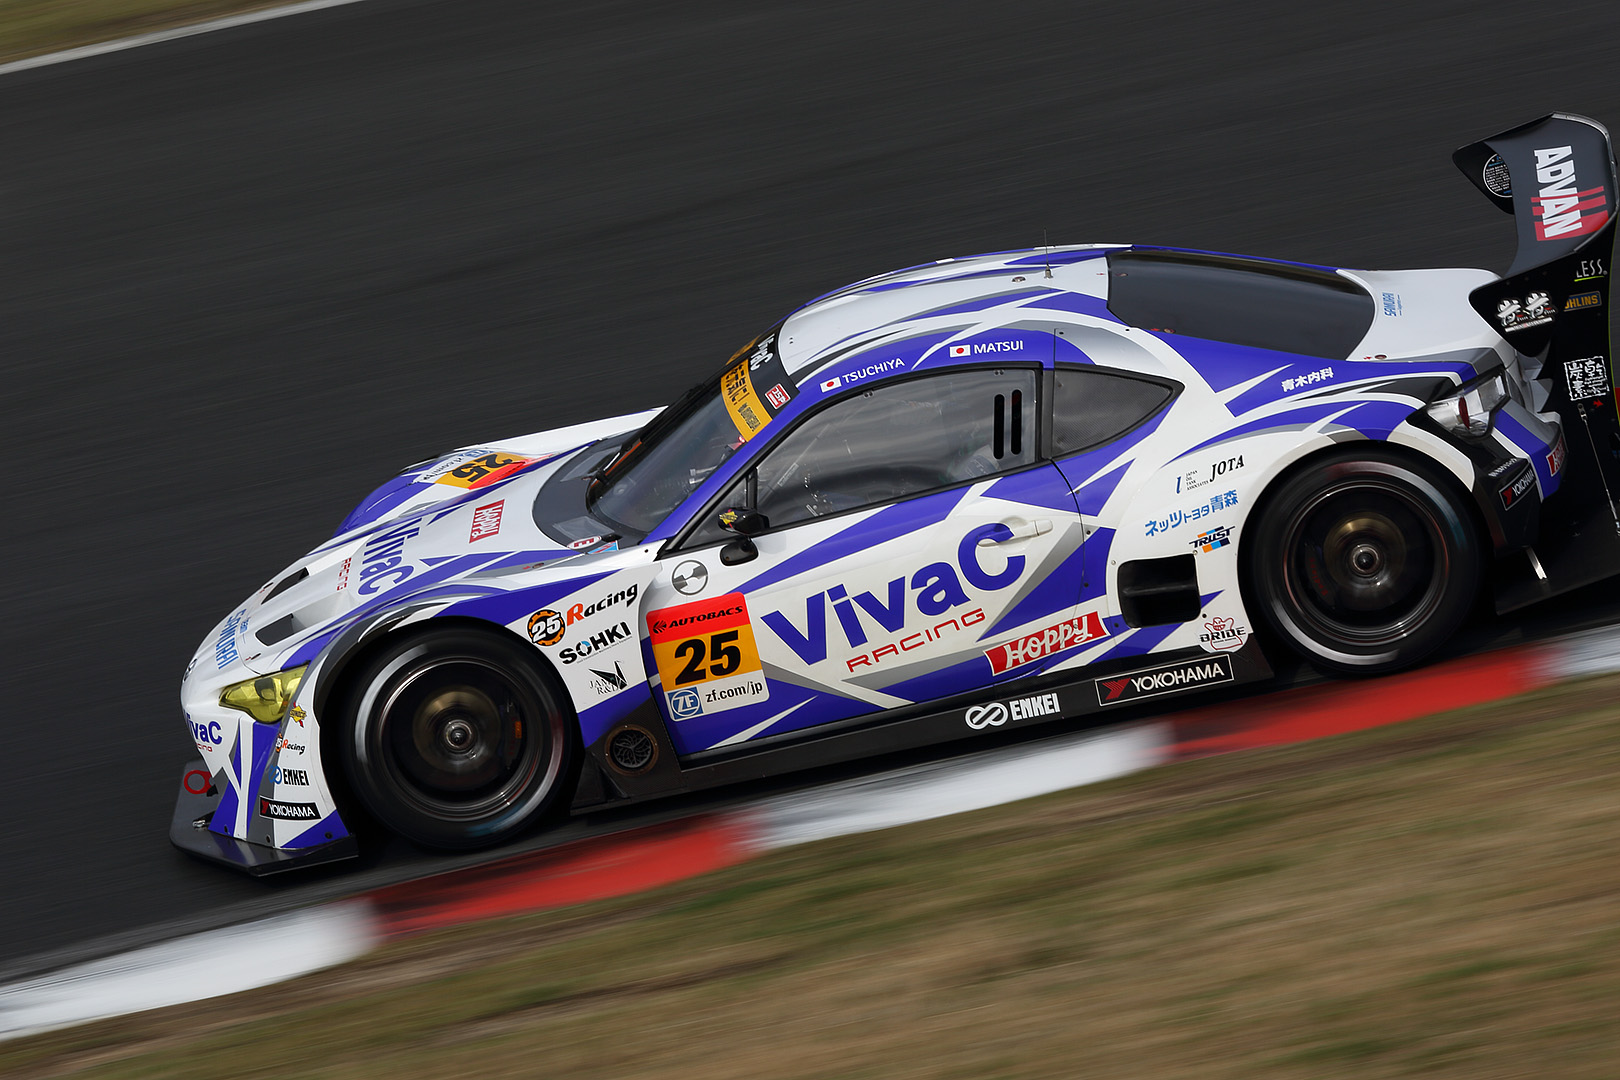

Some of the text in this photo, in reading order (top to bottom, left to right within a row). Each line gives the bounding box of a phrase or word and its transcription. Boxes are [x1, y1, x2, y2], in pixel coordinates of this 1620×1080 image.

[1534, 146, 1583, 238] ADVAN
[973, 340, 1024, 355] MATSUI
[842, 357, 905, 384] TSUCHIYA
[1281, 366, 1334, 392] 青木内科
[452, 453, 513, 482] 25
[1209, 455, 1244, 482] JOTA
[1145, 489, 1239, 537] ネッツトヨタ青森
[1189, 526, 1235, 548] TRUST
[358, 518, 422, 595] VivaC
[760, 523, 1026, 666] VivaC
[531, 583, 638, 644] 25 Racing
[668, 605, 743, 629] AUTOBACS
[216, 608, 247, 669] SAMURAI
[559, 621, 632, 665] SOHKI
[846, 607, 986, 673] RACING
[1003, 616, 1092, 668] Hoppy
[1199, 626, 1246, 643] BRIDE
[674, 629, 741, 686] 25
[1131, 662, 1225, 692] YOKOHAMA
[676, 680, 763, 713] ZF zf.com/jp
[1010, 693, 1060, 721] ENKEI
[282, 739, 306, 756] Racing
[283, 768, 310, 786] ENKEI
[269, 803, 316, 818] YOKOHAMA
